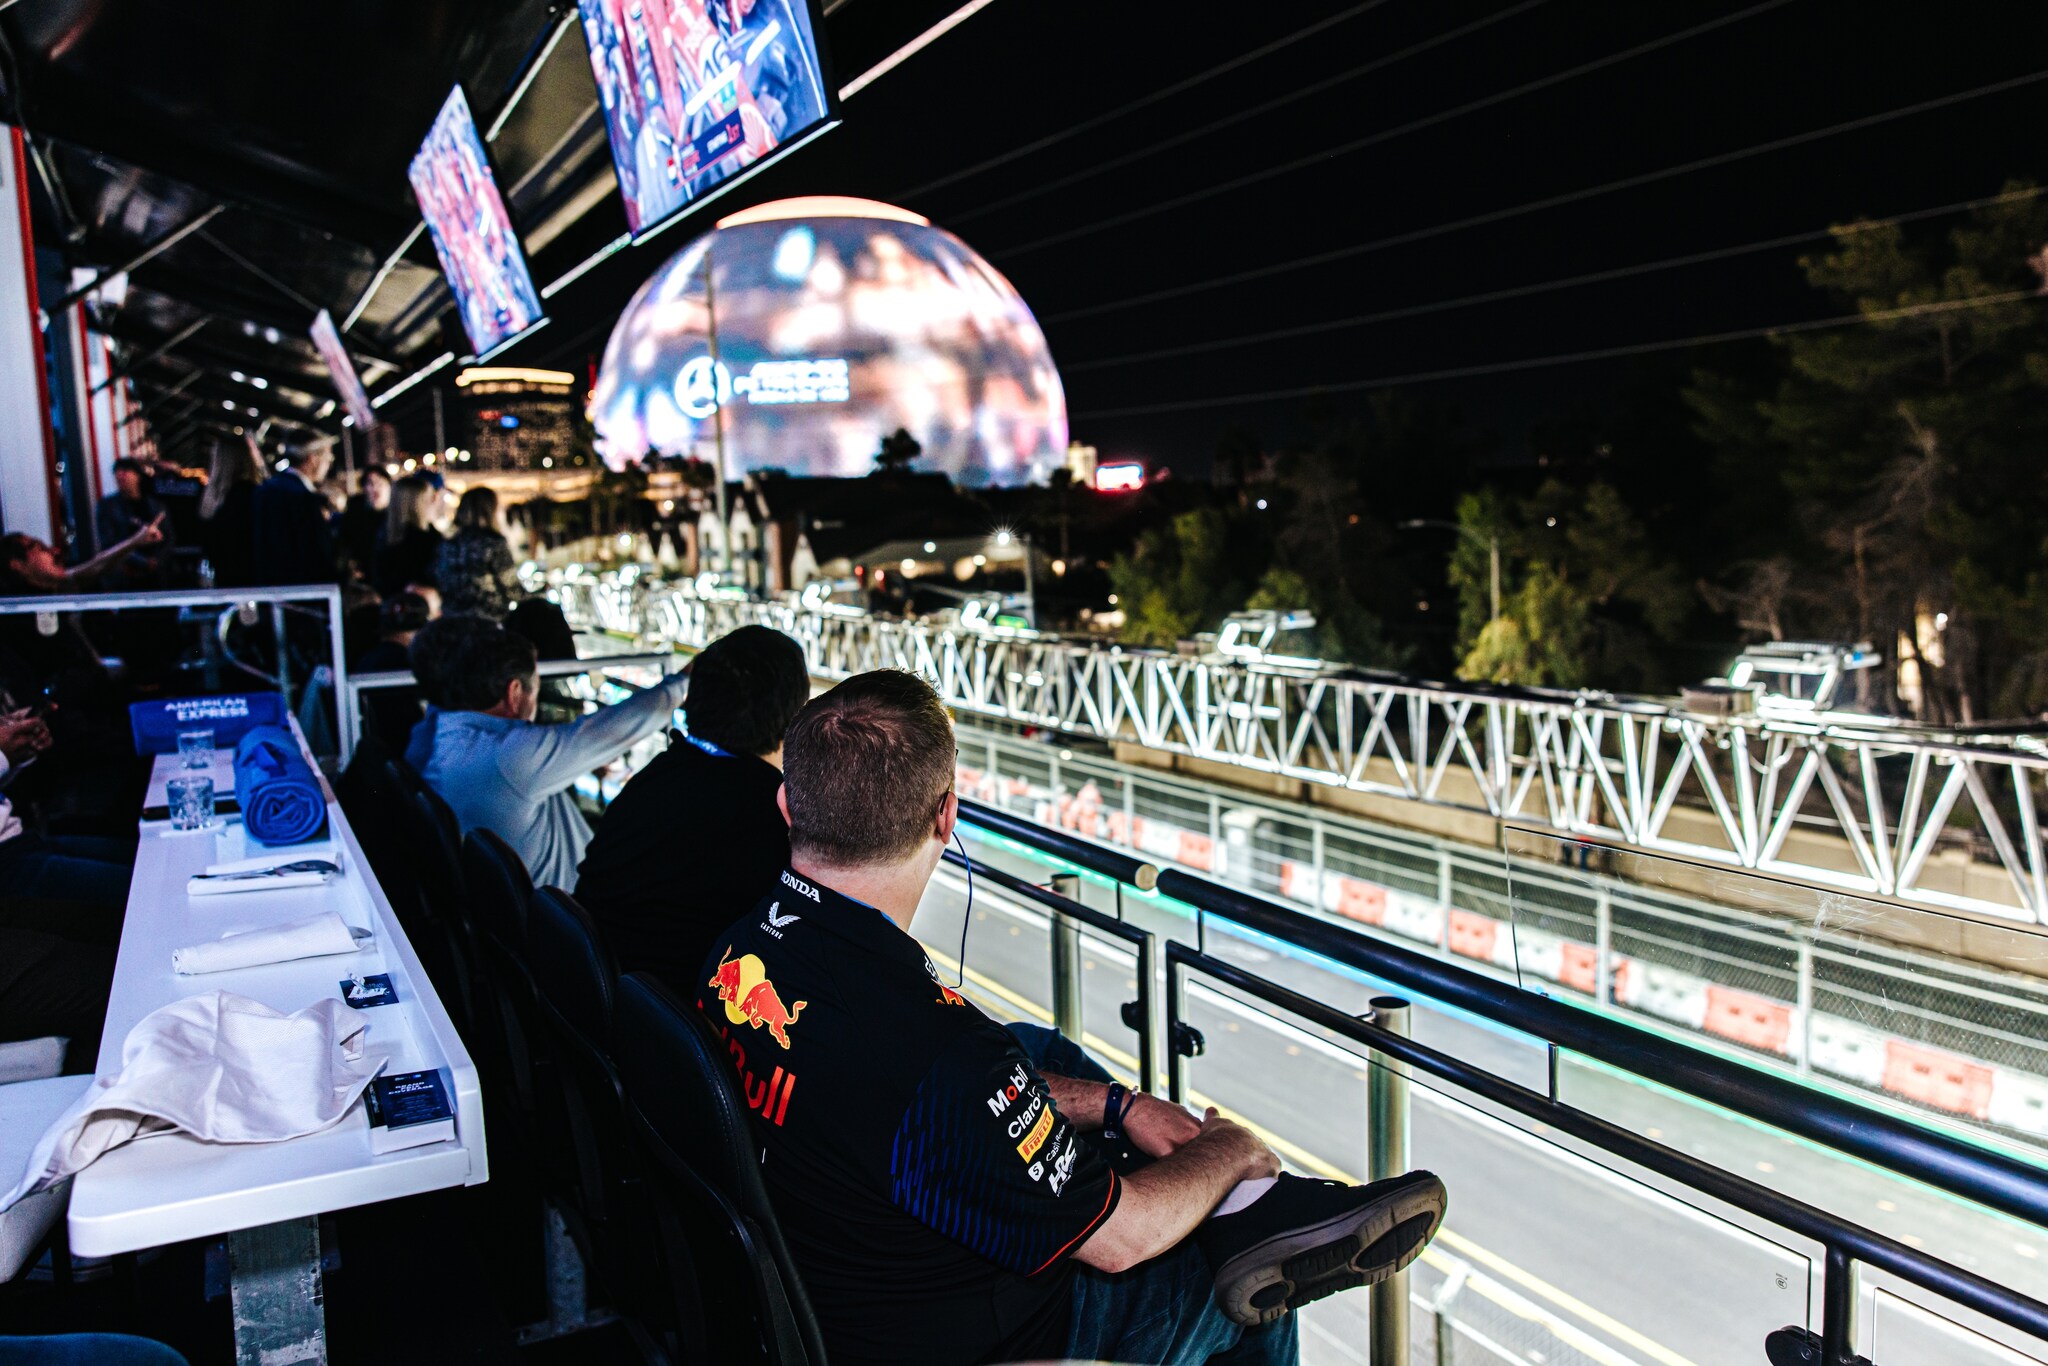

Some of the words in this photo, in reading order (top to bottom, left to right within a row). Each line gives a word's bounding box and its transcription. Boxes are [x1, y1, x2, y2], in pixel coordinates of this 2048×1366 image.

[177, 707, 248, 720] EXPRESS
[760, 922, 783, 939] CASTORE
[987, 1063, 1028, 1117] Mobil
[1008, 1095, 1041, 1138] Claro
[1021, 1109, 1052, 1156] PIRELLI
[1046, 1141, 1061, 1161] Cash
[1048, 1136, 1076, 1193] HRC
